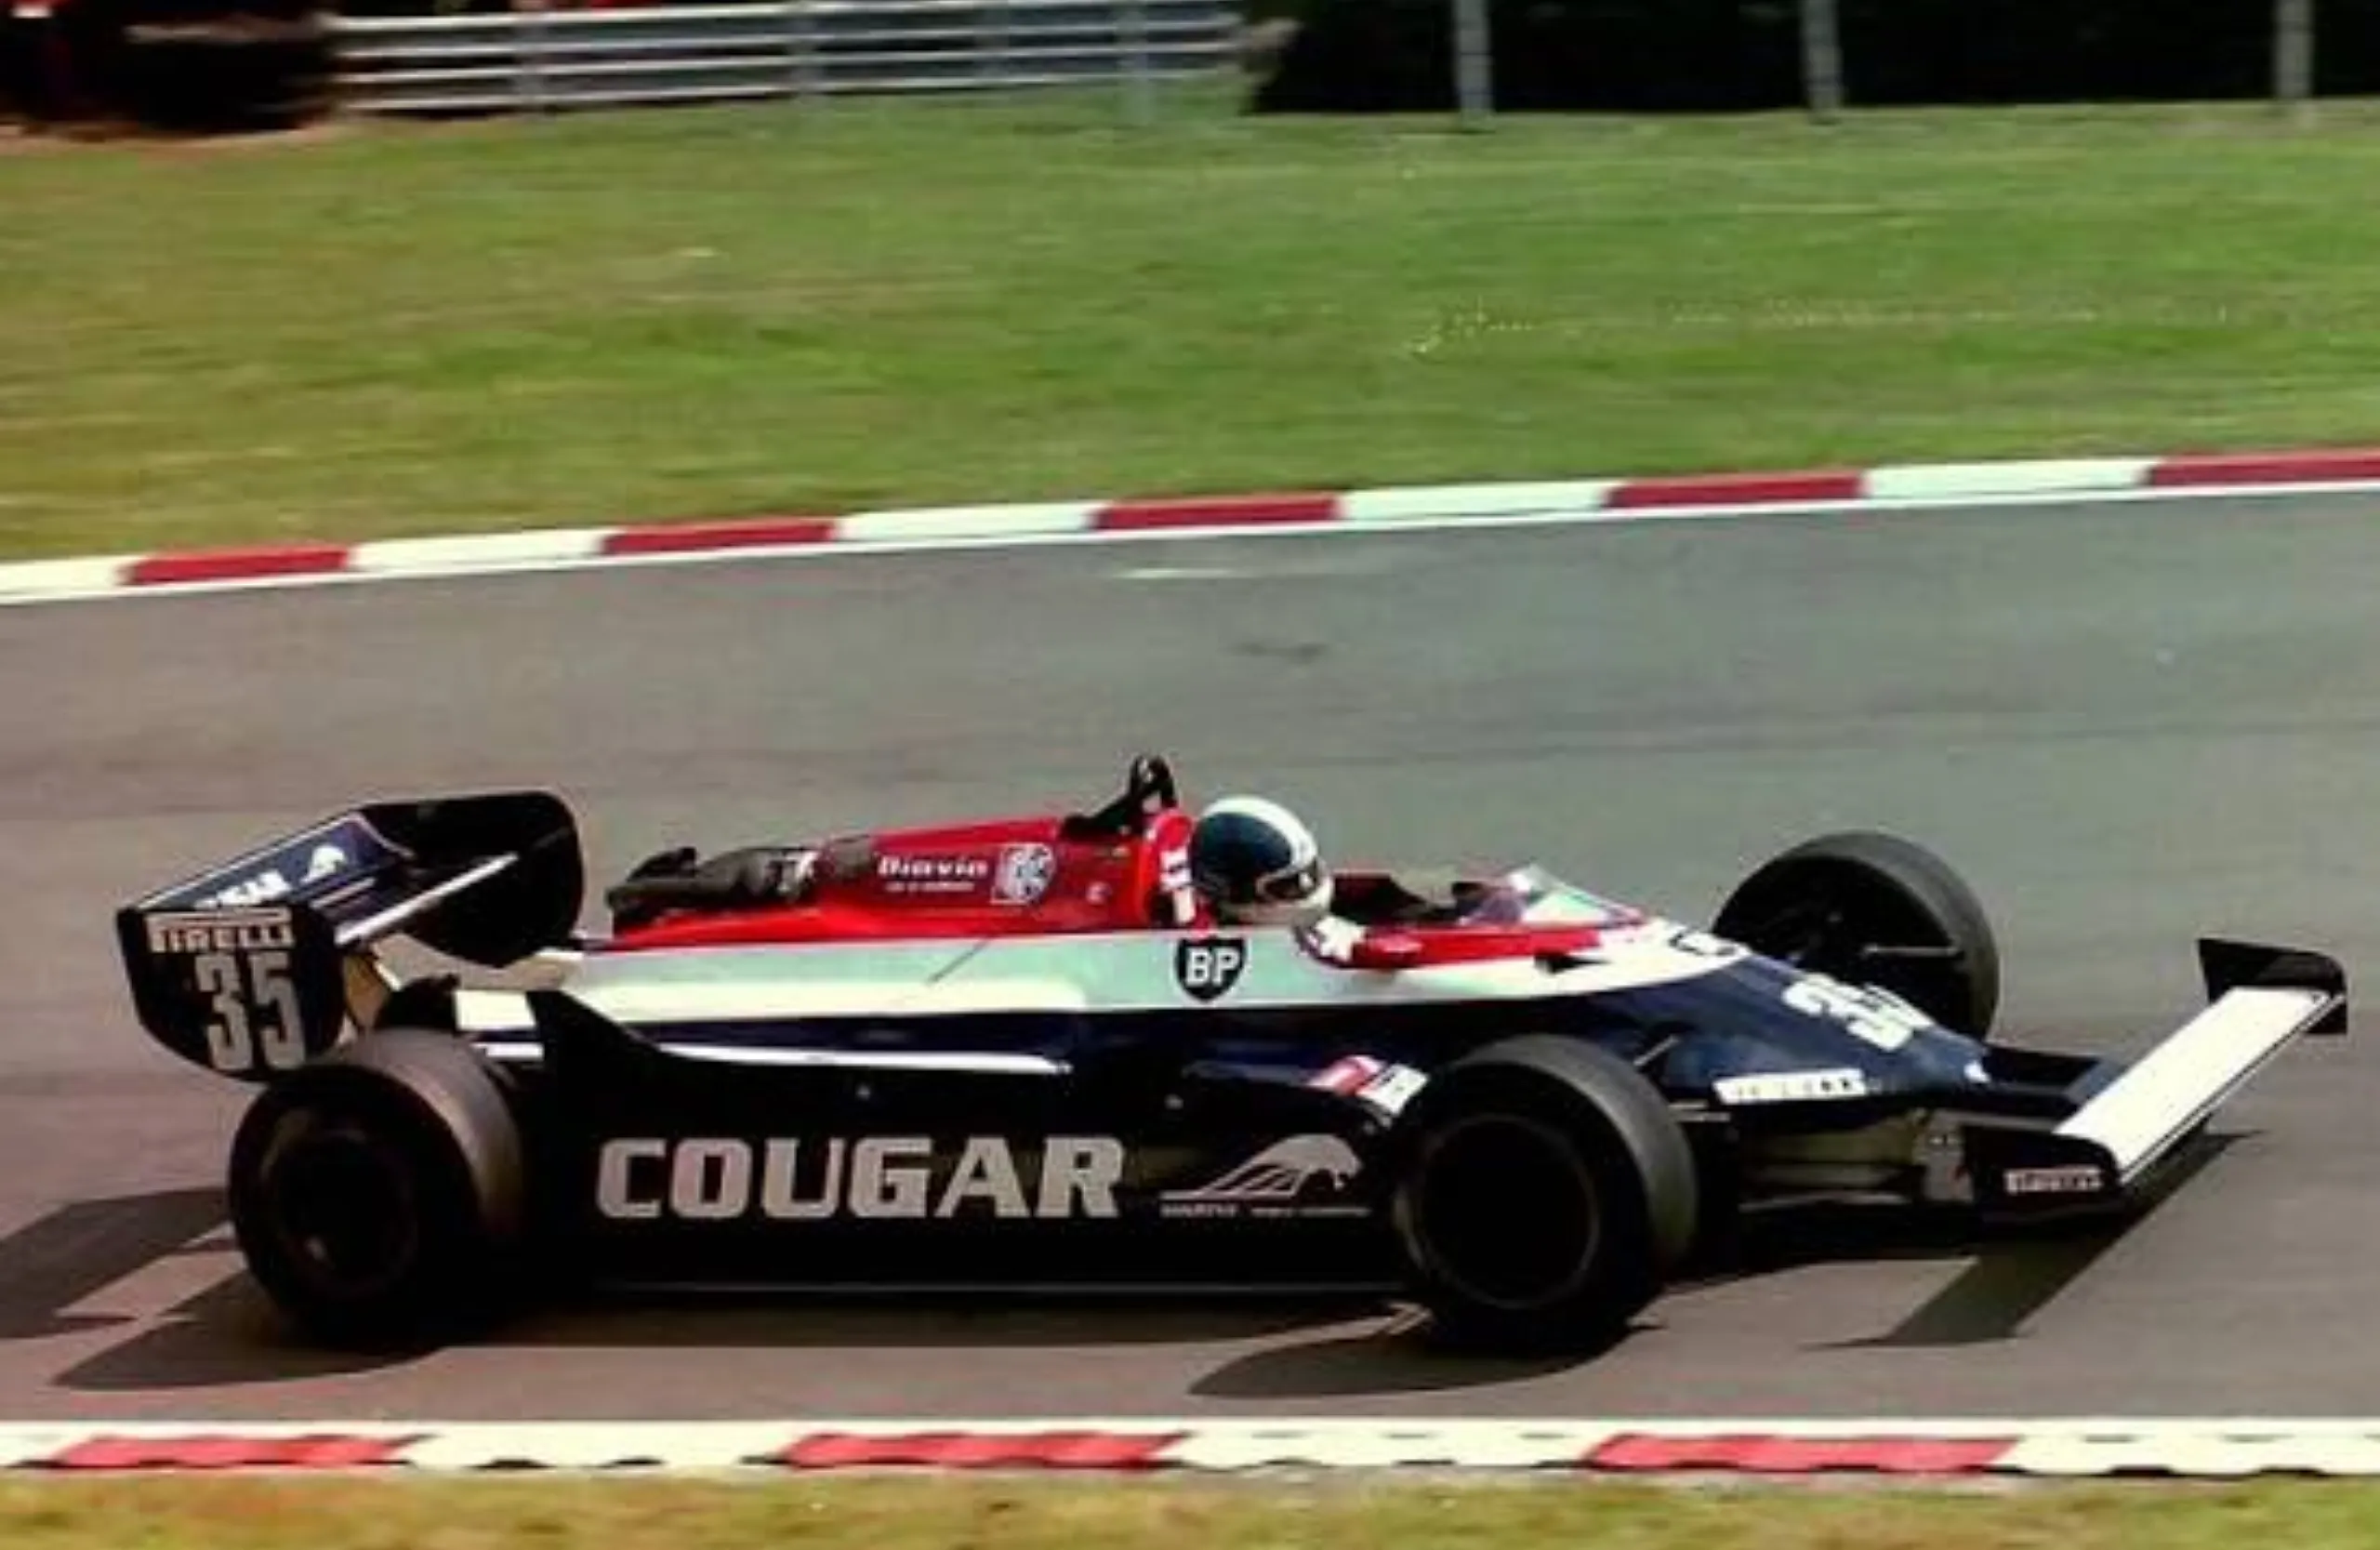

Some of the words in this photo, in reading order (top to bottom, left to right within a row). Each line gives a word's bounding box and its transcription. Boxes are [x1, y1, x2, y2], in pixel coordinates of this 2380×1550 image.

[1185, 947, 1241, 986] BP
[194, 950, 307, 1071] 35
[596, 1137, 1128, 1220] COUGAR
